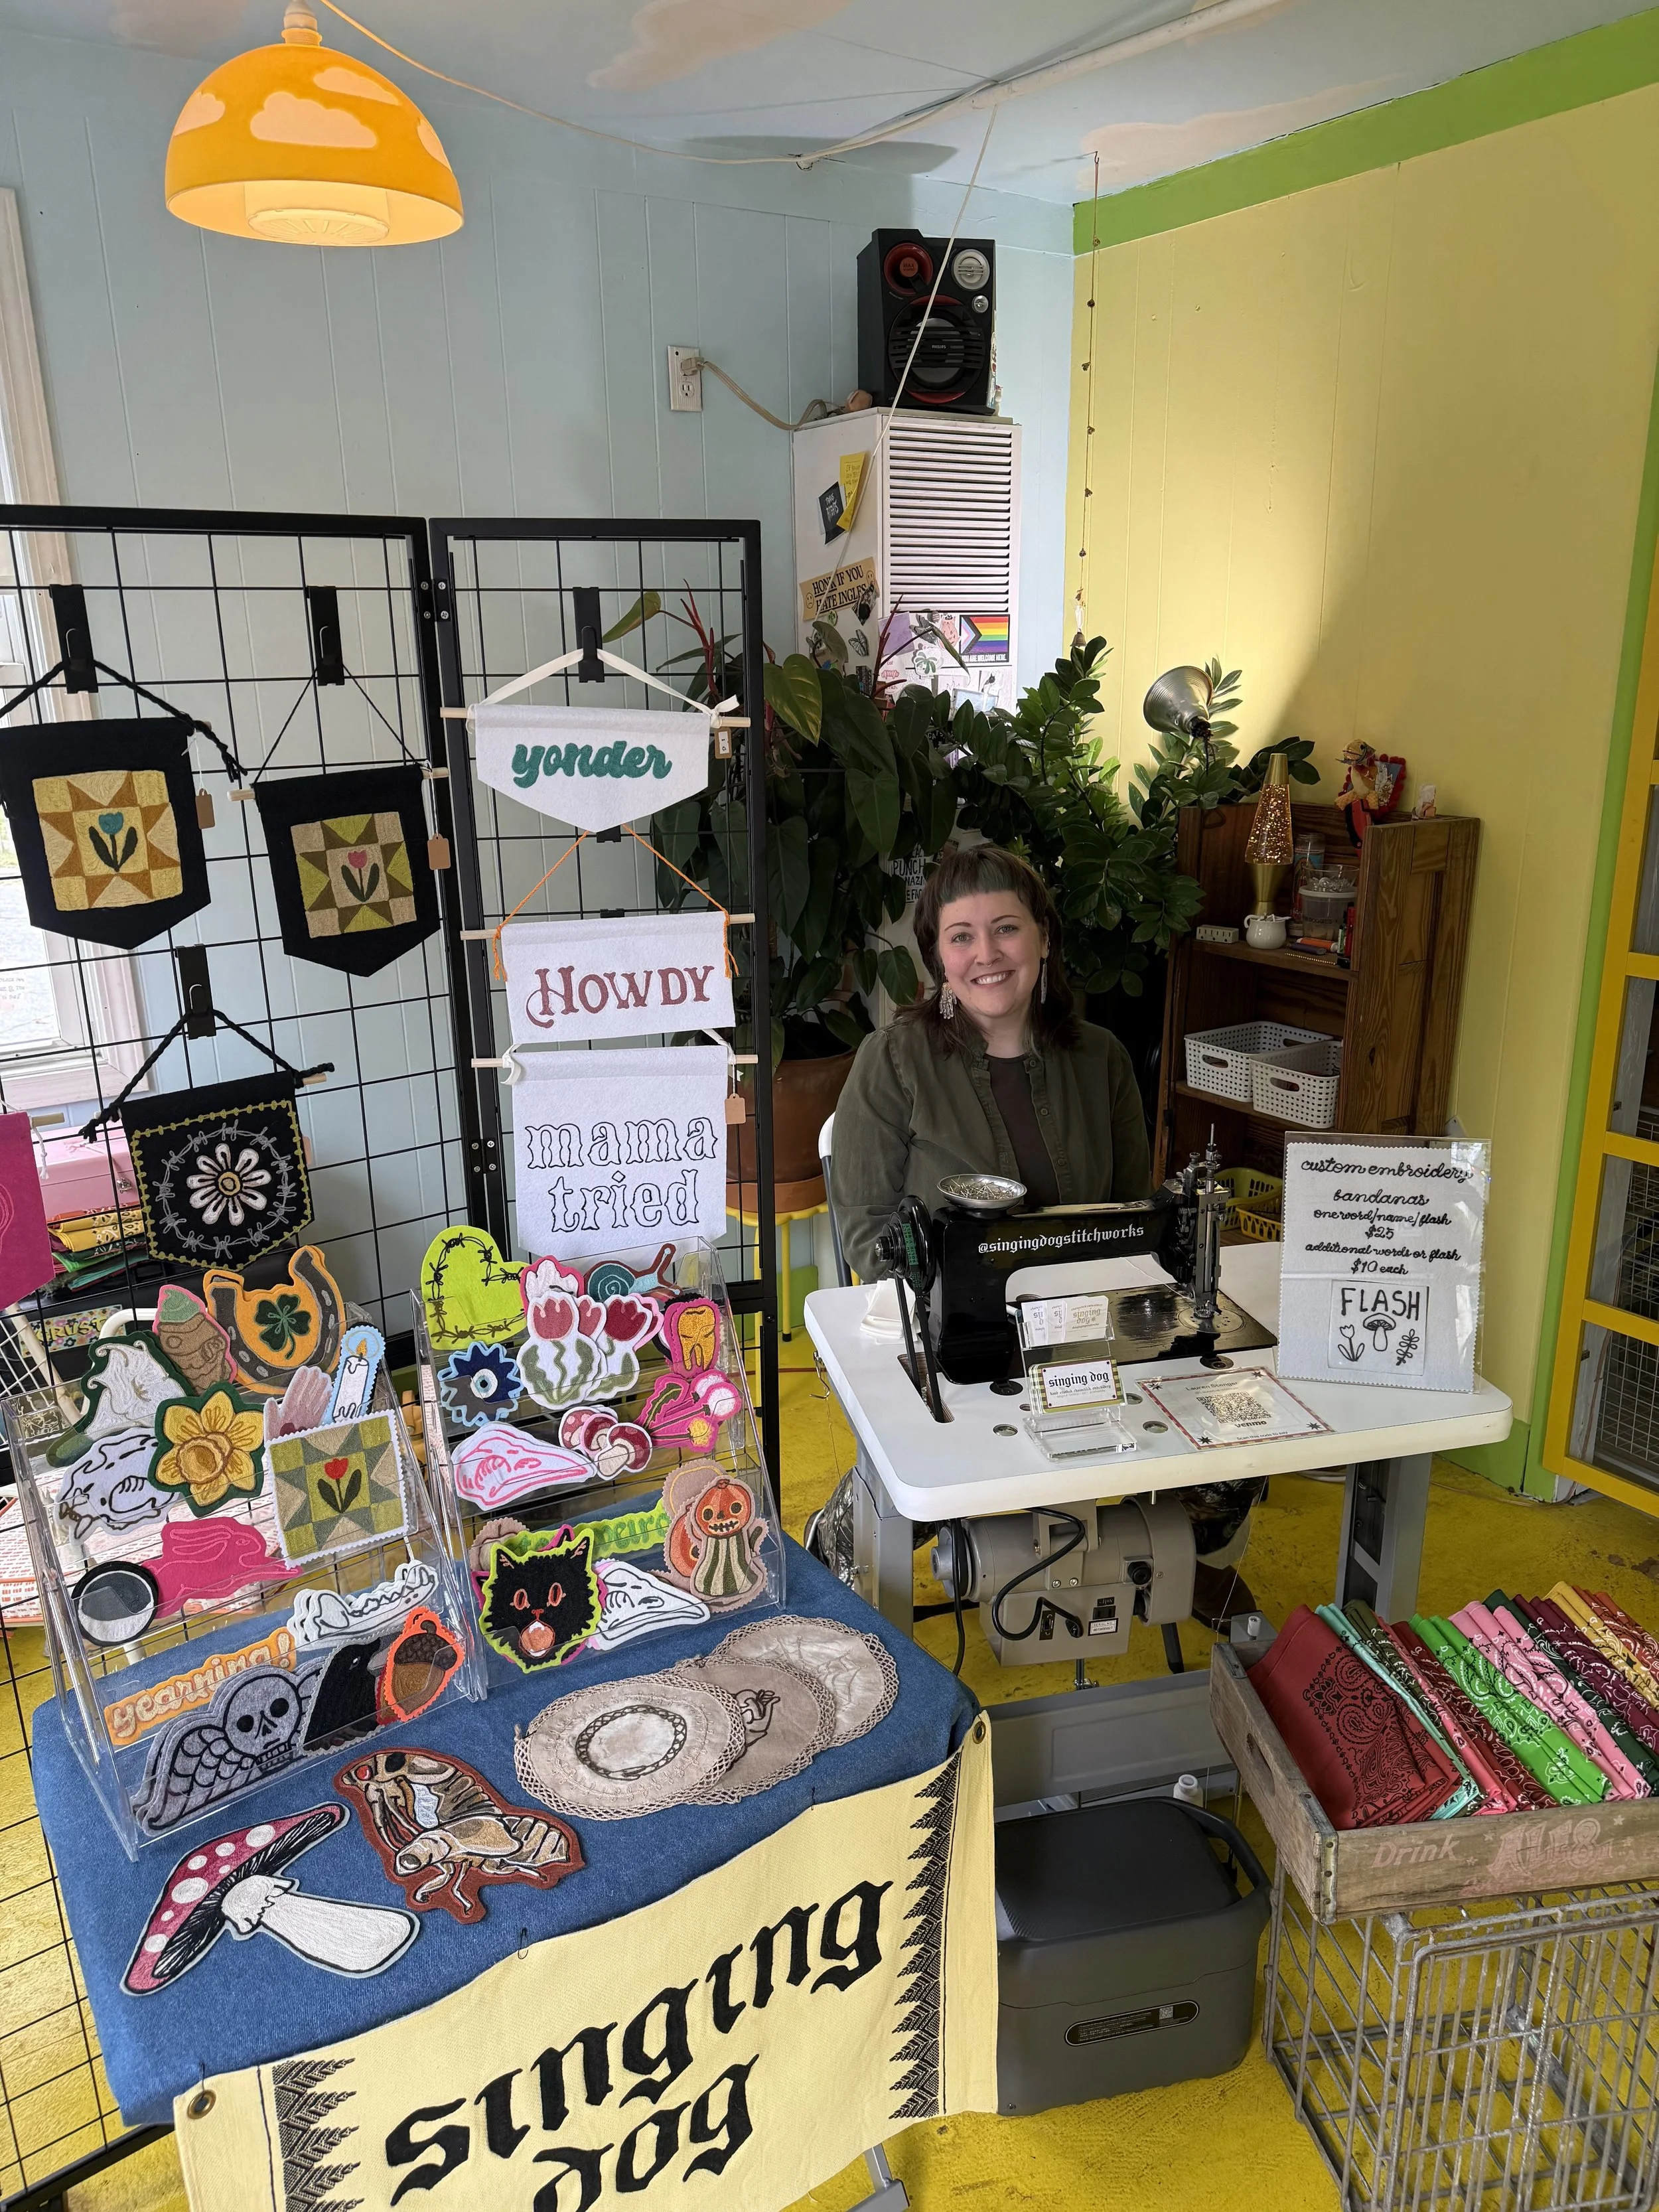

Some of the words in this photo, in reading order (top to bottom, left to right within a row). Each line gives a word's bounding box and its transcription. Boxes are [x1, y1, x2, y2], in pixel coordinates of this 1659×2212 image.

[812, 577, 837, 595] HONK
[837, 573, 845, 586] IF
[845, 565, 864, 582] YOU
[816, 594, 838, 613] HATE
[512, 740, 673, 788] yonder
[893, 858, 926, 876] PUNCH
[525, 1117, 718, 1169] mama
[1301, 1157, 1366, 1174] custom
[1368, 1161, 1473, 1183] embroidery
[549, 1169, 700, 1233] tried
[1334, 1189, 1429, 1206] bandanas
[978, 1223, 1145, 1254] @singingdogstitchworks
[1365, 1224, 1394, 1240] $25
[1305, 1241, 1373, 1255] additional
[1373, 1246, 1412, 1258] words
[1413, 1250, 1427, 1260] or
[1429, 1249, 1462, 1262] flash
[1351, 1258, 1378, 1274] $10
[1379, 1264, 1409, 1275] each
[1072, 1307, 1102, 1319] singing
[1341, 1288, 1420, 1321] FLASH
[1048, 1372, 1088, 1388] singing
[1089, 1371, 1110, 1383] dog
[1236, 1420, 1267, 1429] venmo
[111, 1631, 292, 1737] yearning!
[1371, 1834, 1463, 1869] Drink
[386, 1880, 893, 2206] singing
[531, 2053, 760, 2212] dog
